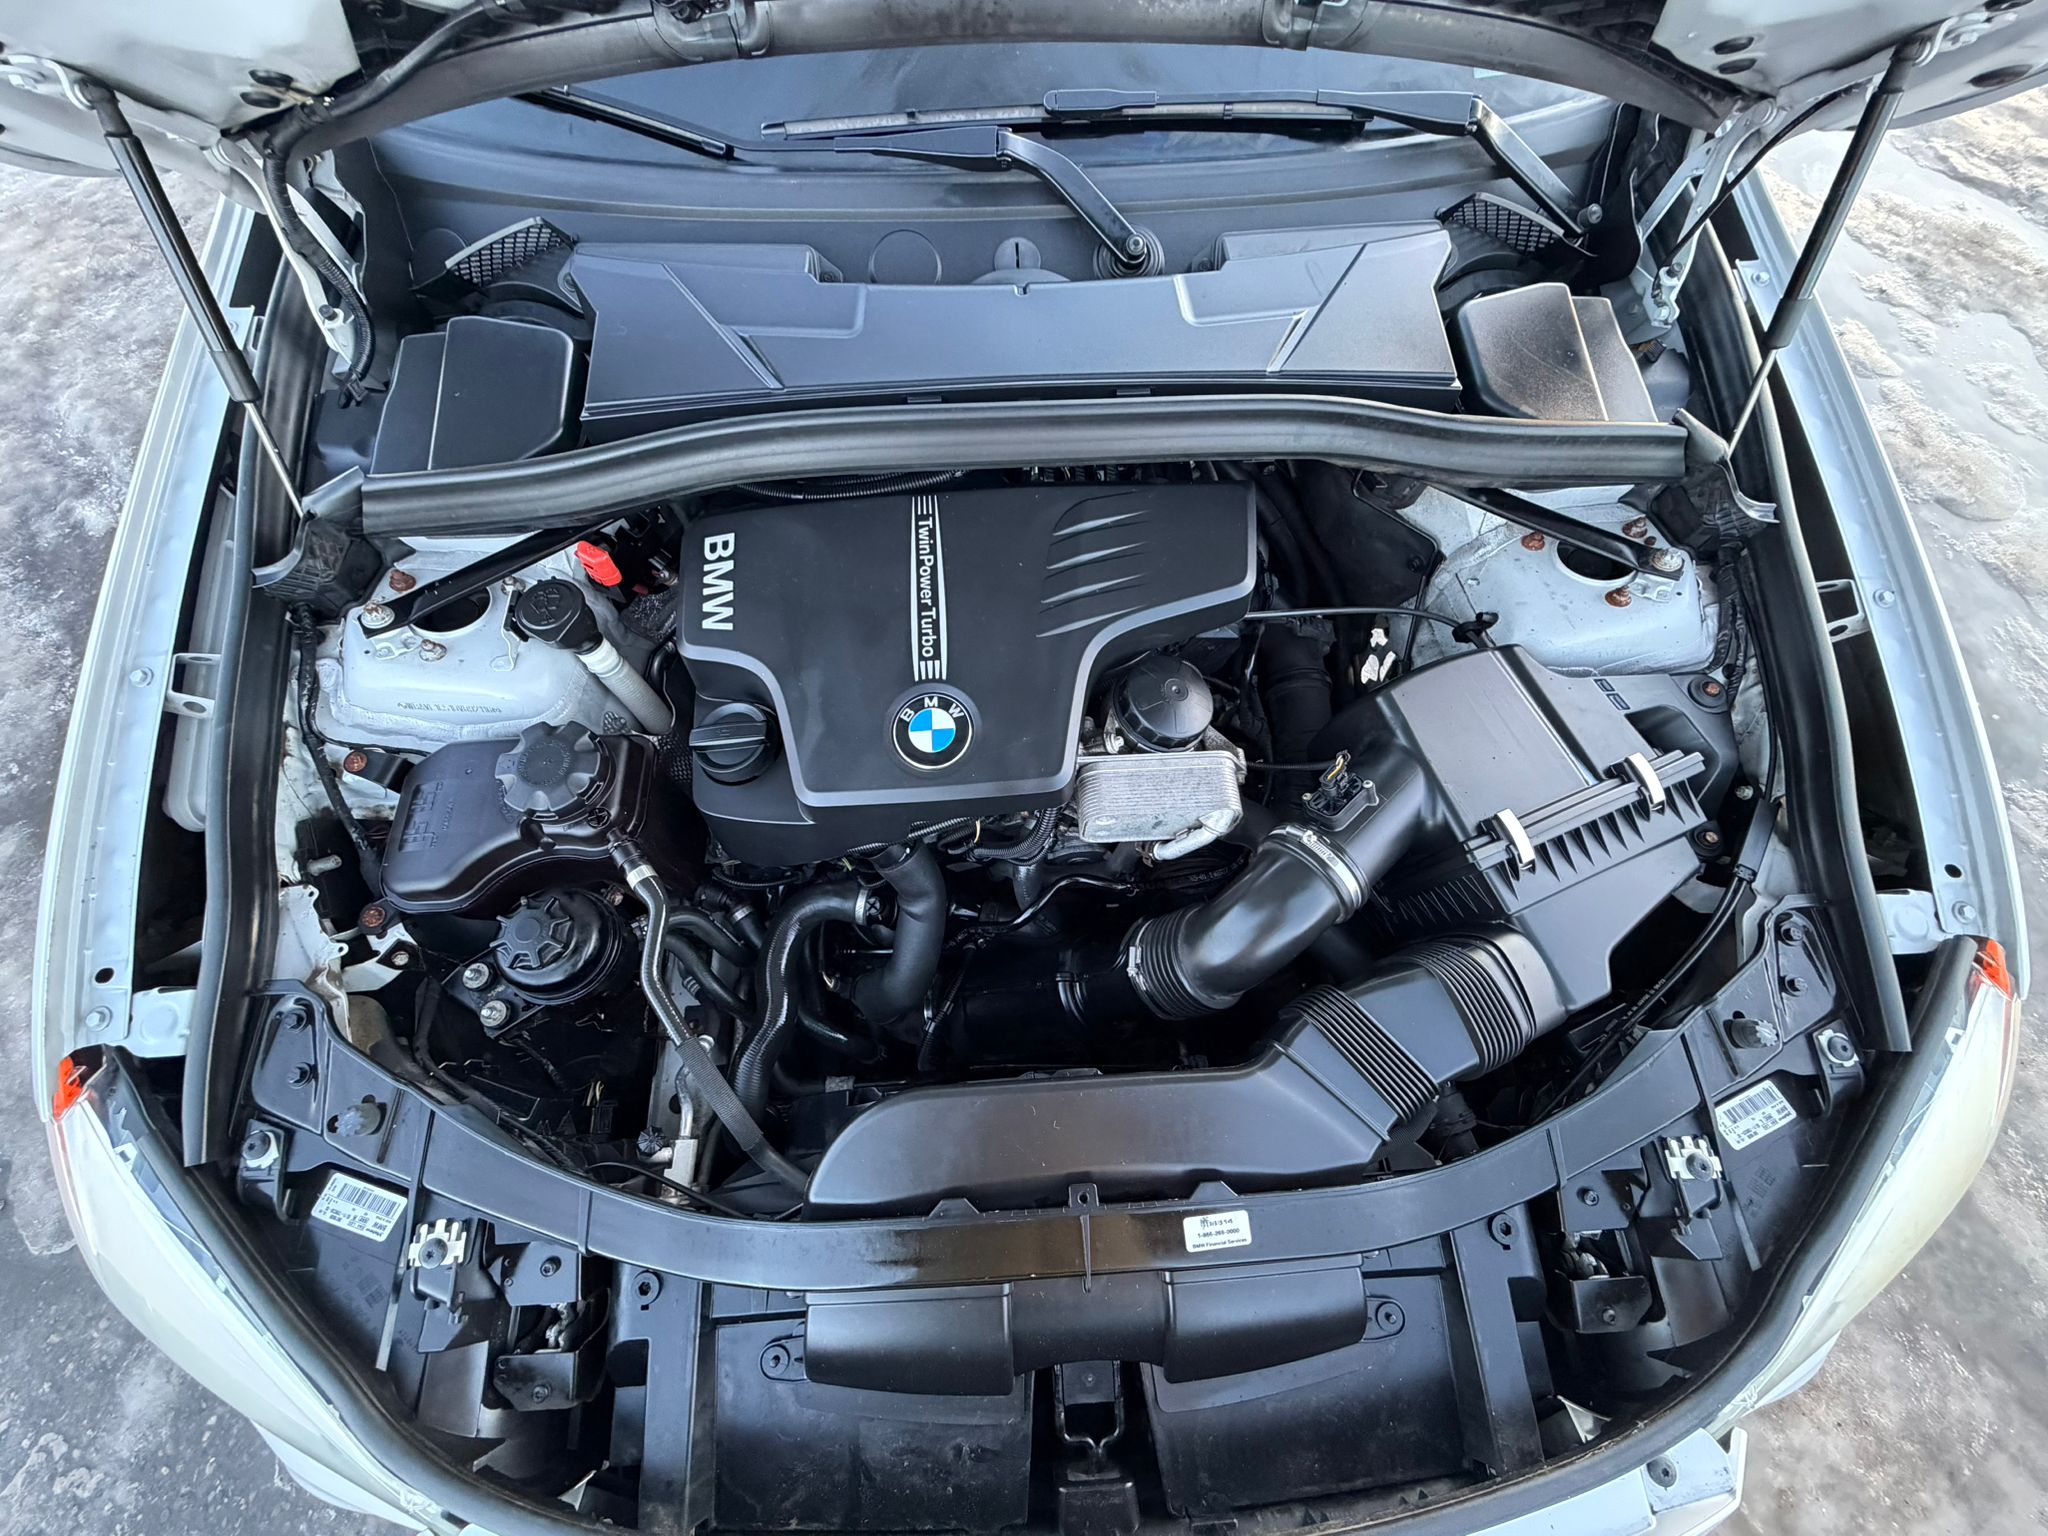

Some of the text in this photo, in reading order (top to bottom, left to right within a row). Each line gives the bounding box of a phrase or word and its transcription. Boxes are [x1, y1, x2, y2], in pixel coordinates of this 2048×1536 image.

[702, 532, 735, 631] BMW
[918, 516, 937, 658] TwinPower Turbo
[900, 696, 964, 722] BMW
